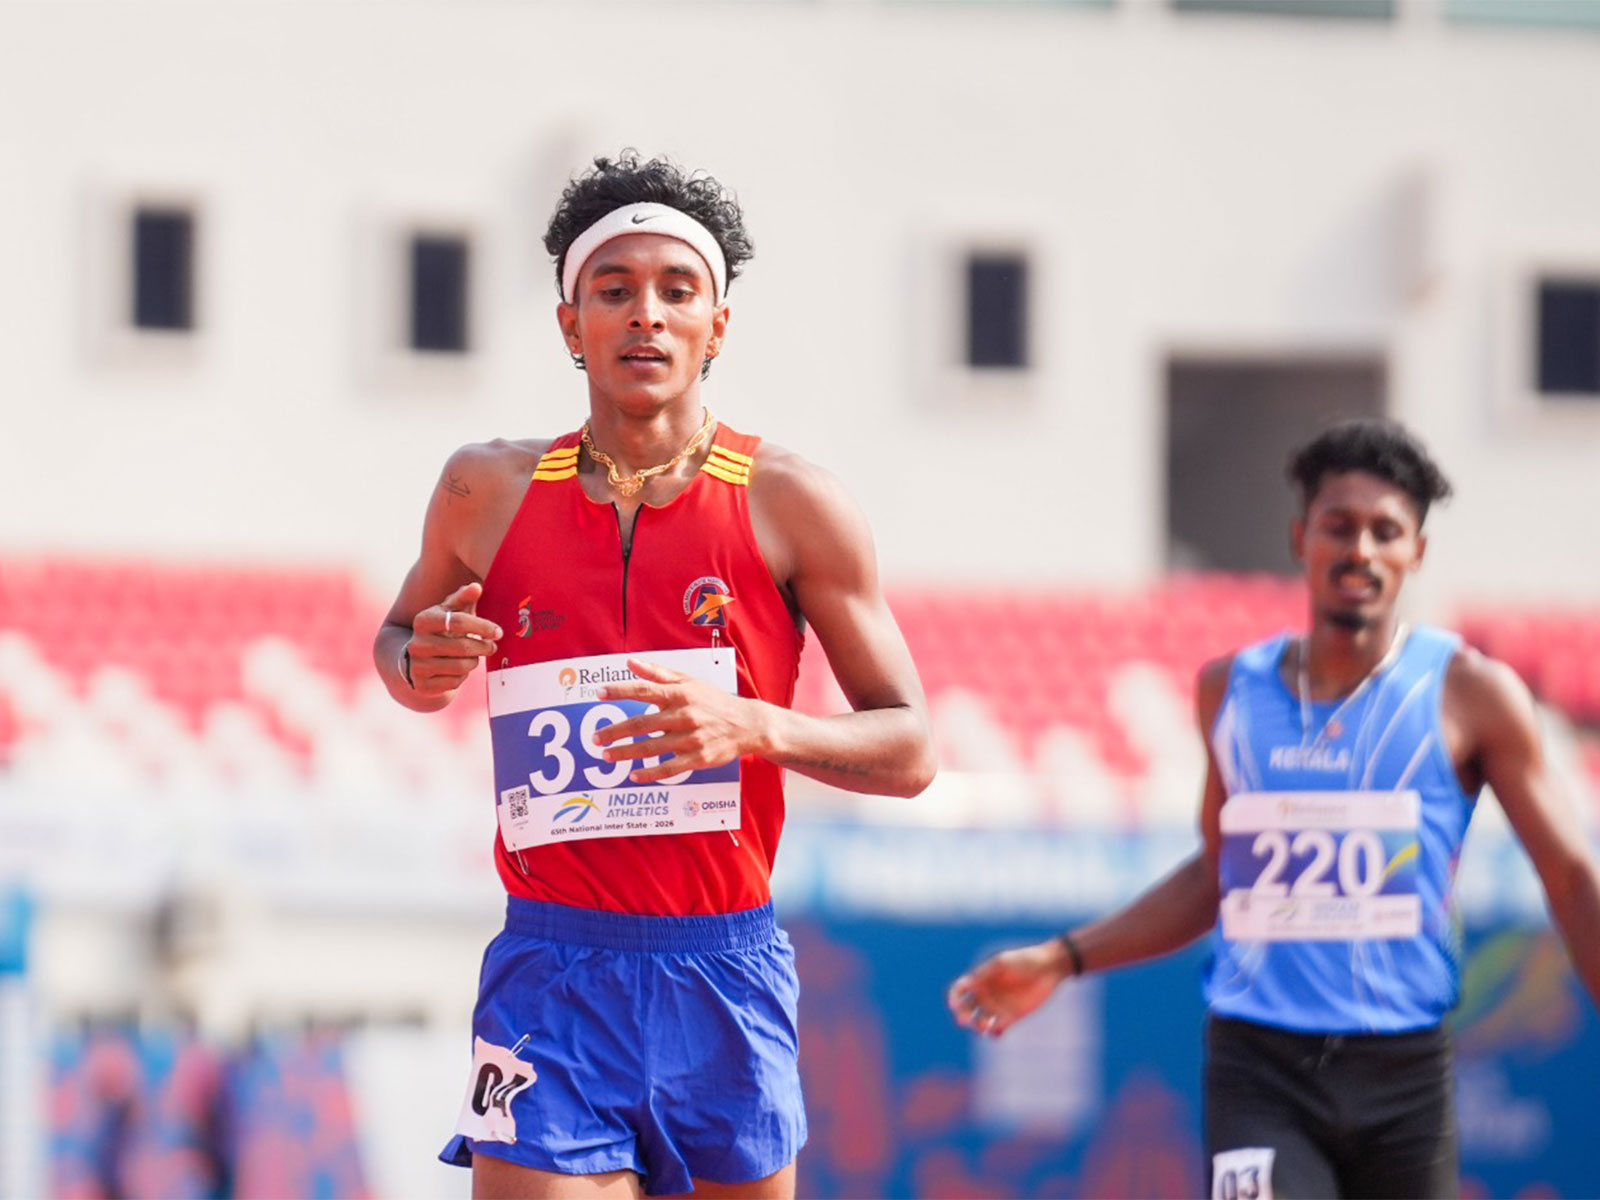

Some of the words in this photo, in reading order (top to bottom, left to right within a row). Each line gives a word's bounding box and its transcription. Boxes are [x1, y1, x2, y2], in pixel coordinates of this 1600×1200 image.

[579, 666, 640, 685] Relian
[608, 791, 669, 806] INDIAN
[701, 800, 737, 810] ODISHA
[606, 806, 669, 818] ATHLETICS
[550, 828, 567, 836] 65th
[569, 825, 602, 833] National
[604, 823, 624, 831] Inter
[626, 821, 648, 829] State
[655, 819, 675, 828] 2026
[1252, 829, 1386, 898] 220
[472, 1062, 529, 1118] 04
[1222, 1166, 1260, 1200] 03
